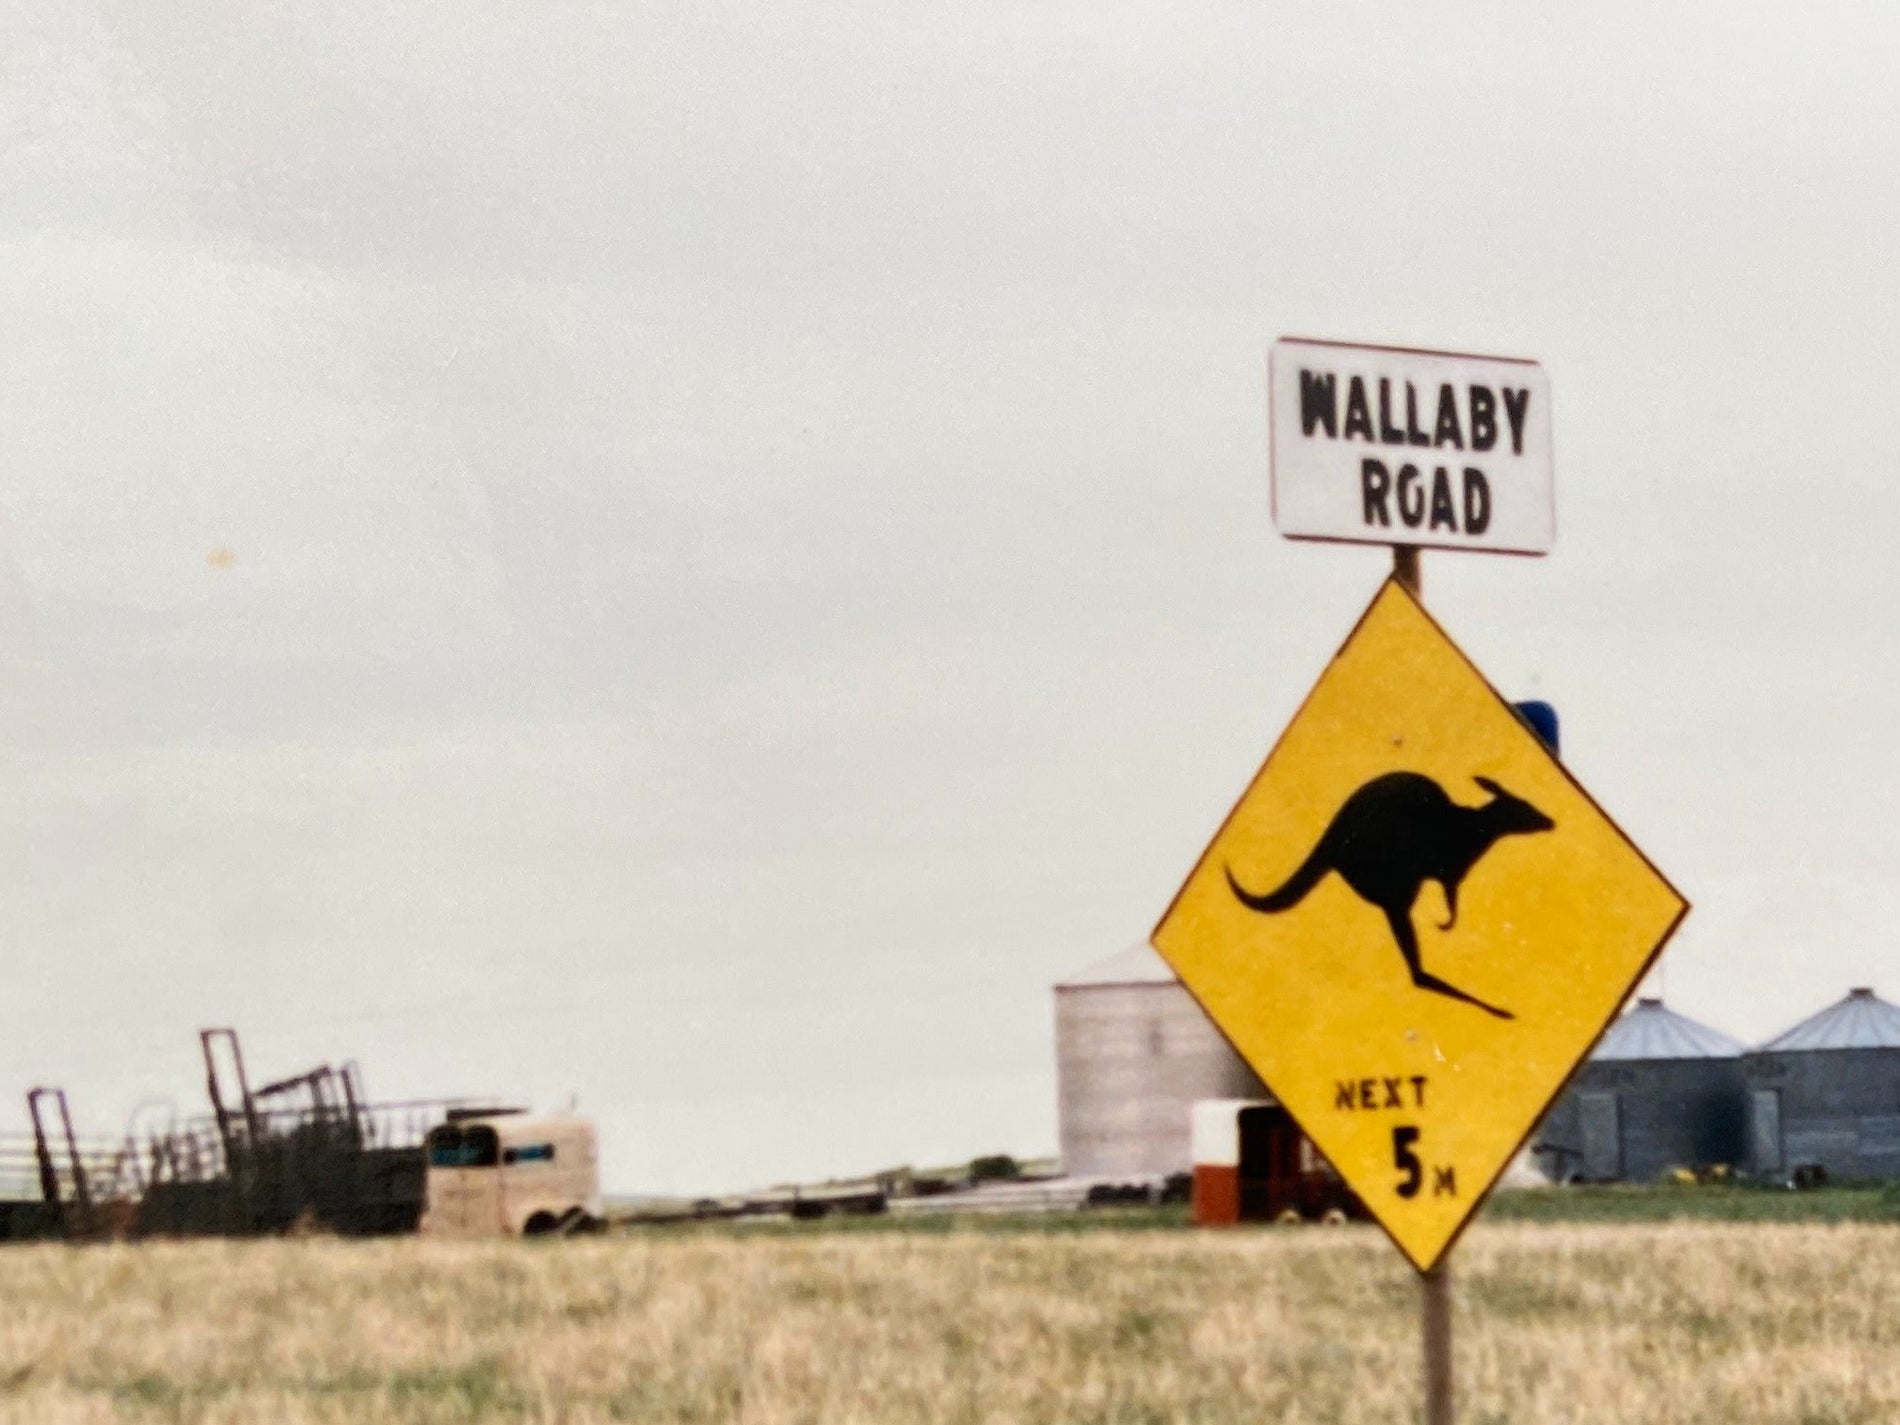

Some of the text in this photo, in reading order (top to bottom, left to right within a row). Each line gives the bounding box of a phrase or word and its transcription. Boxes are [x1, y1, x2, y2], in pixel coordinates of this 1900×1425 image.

[1299, 368, 1529, 456] WALLABY
[1361, 457, 1492, 535] ROAD
[1336, 1076, 1426, 1110] NEXT
[1393, 1127, 1421, 1198] 5
